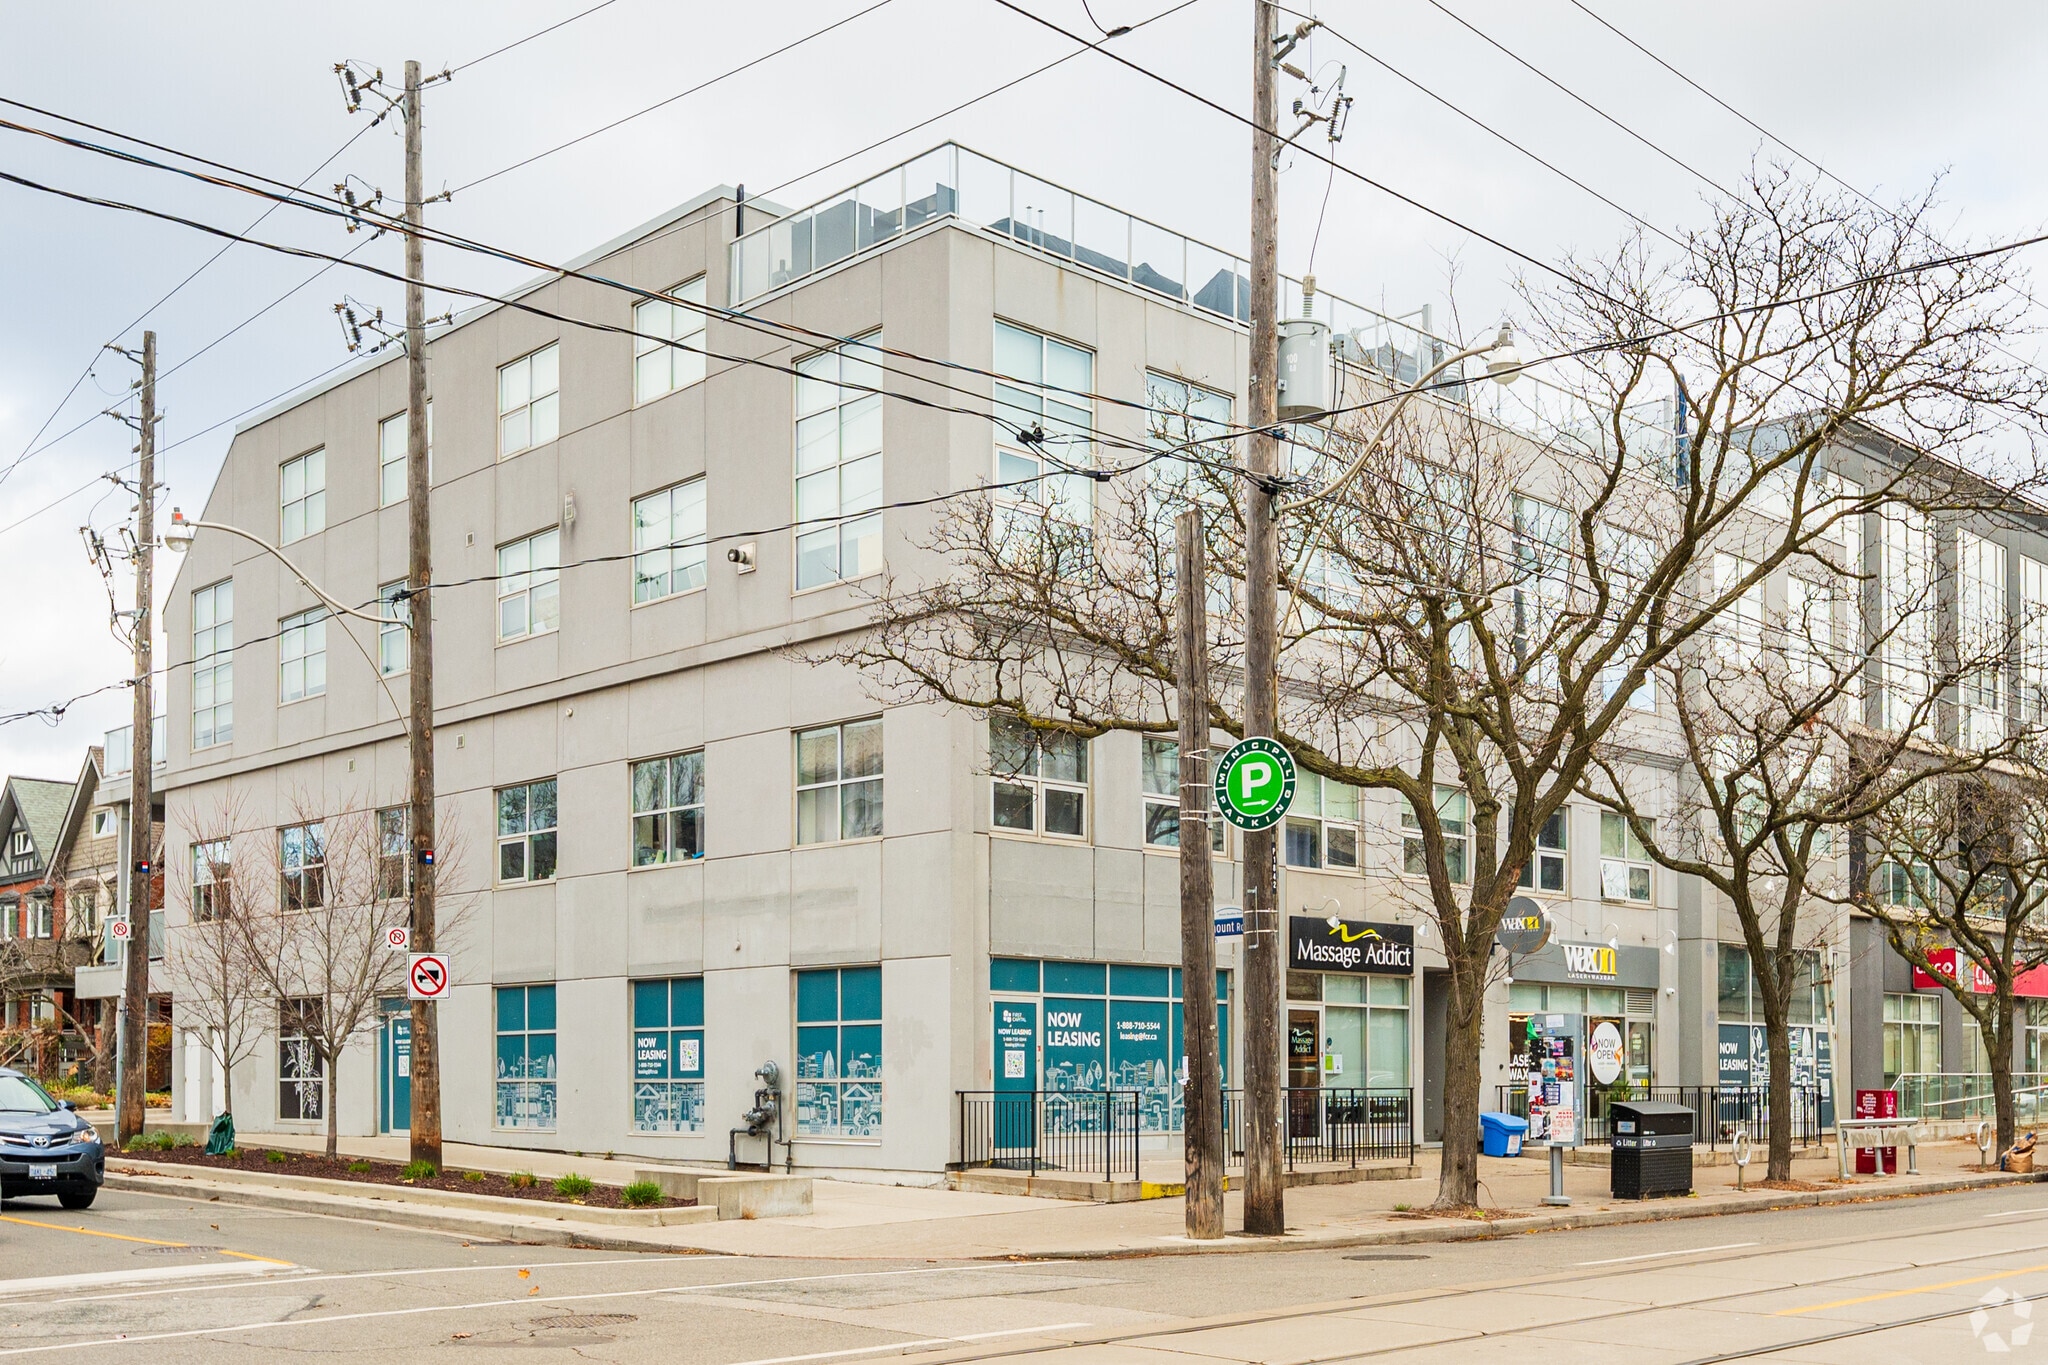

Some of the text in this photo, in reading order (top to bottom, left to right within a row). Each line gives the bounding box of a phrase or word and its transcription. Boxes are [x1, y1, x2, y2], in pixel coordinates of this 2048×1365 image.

[1218, 742, 1292, 784] MUNICIPAL
[1241, 762, 1272, 799] P
[1219, 789, 1292, 827] PARKING
[1214, 921, 1235, 934] ount
[1297, 938, 1411, 968] Massage Addict
[1047, 1012, 1082, 1028] NOW
[1116, 1021, 1160, 1030] 1-888-710-5544
[1011, 1028, 1032, 1036] LEASING
[1120, 1032, 1157, 1041] leasing@fcr.ca
[637, 1037, 657, 1048] NOW
[1047, 1031, 1101, 1047] LEASING
[1291, 1036, 1314, 1045] Massage
[1598, 1038, 1616, 1048] NOW
[1294, 1045, 1312, 1054] Addict
[1719, 1042, 1738, 1054] NOW
[638, 1049, 667, 1060] LEASING
[1596, 1049, 1617, 1060] OPEN
[1509, 1054, 1529, 1067] ASE
[1719, 1059, 1749, 1071] LEASING
[1622, 1138, 1637, 1147] Litter
